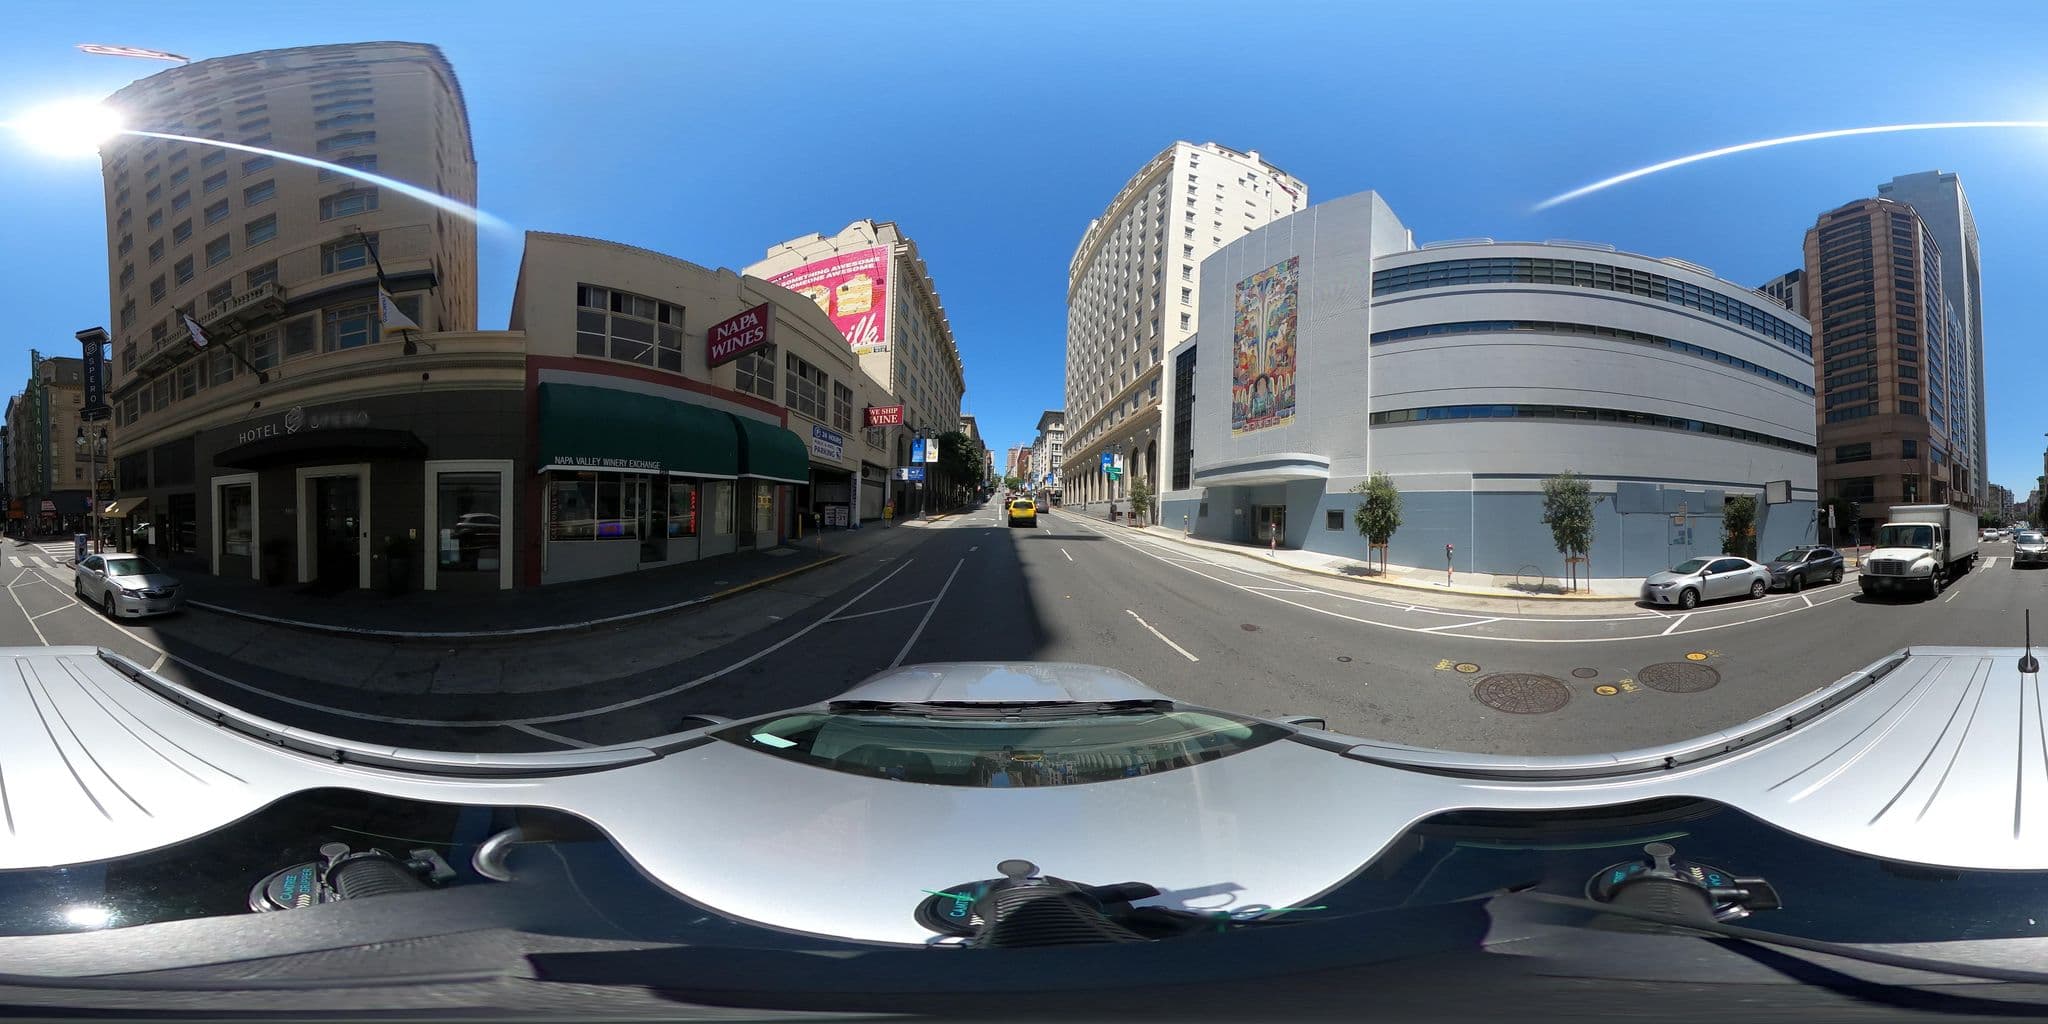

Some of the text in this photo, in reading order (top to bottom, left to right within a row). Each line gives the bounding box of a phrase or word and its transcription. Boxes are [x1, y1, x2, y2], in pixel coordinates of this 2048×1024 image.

[781, 267, 830, 287] SOMETHING
[830, 256, 881, 272] AWESOME
[786, 273, 826, 290] SOMEONE
[826, 263, 876, 279] AWESOME
[716, 312, 759, 341] NAPA
[841, 312, 880, 346] ilk
[711, 326, 764, 360] WINES
[89, 358, 97, 402] SPERO
[870, 414, 898, 425] WINE
[881, 407, 898, 415] SHIP
[239, 423, 280, 444] HOTEL
[554, 455, 661, 469] NAPA VALLEY WINERY EXCHANGE
